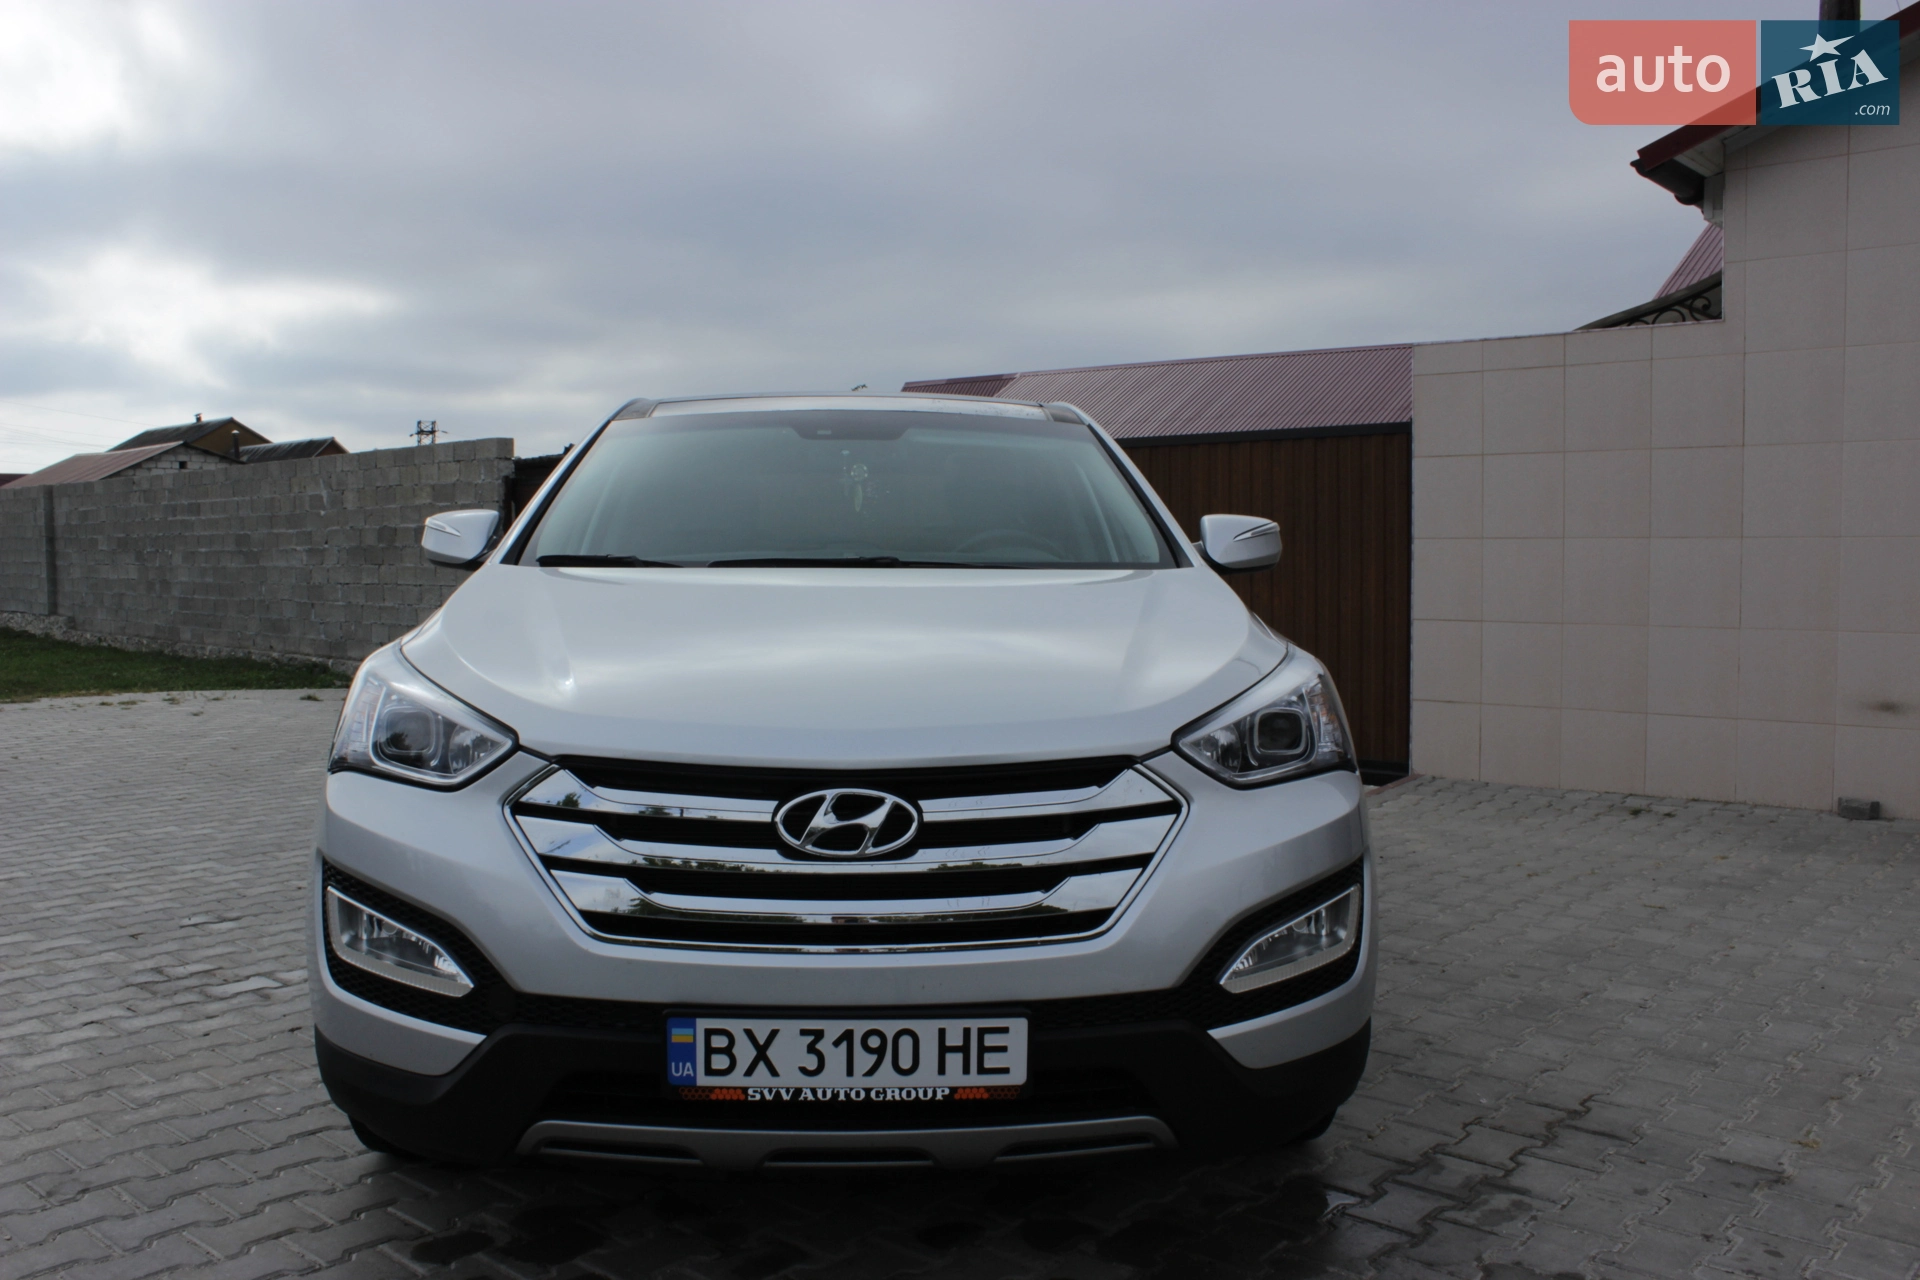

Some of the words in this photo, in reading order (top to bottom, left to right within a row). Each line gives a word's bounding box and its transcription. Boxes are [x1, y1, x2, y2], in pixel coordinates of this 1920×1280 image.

[703, 1027, 781, 1077] BX
[797, 1028, 920, 1077] 3190
[937, 1026, 1011, 1076] HE
[671, 1062, 694, 1077] UA
[747, 1087, 798, 1101] SVV
[799, 1087, 865, 1101] AUTO
[870, 1087, 950, 1101] GROUP
